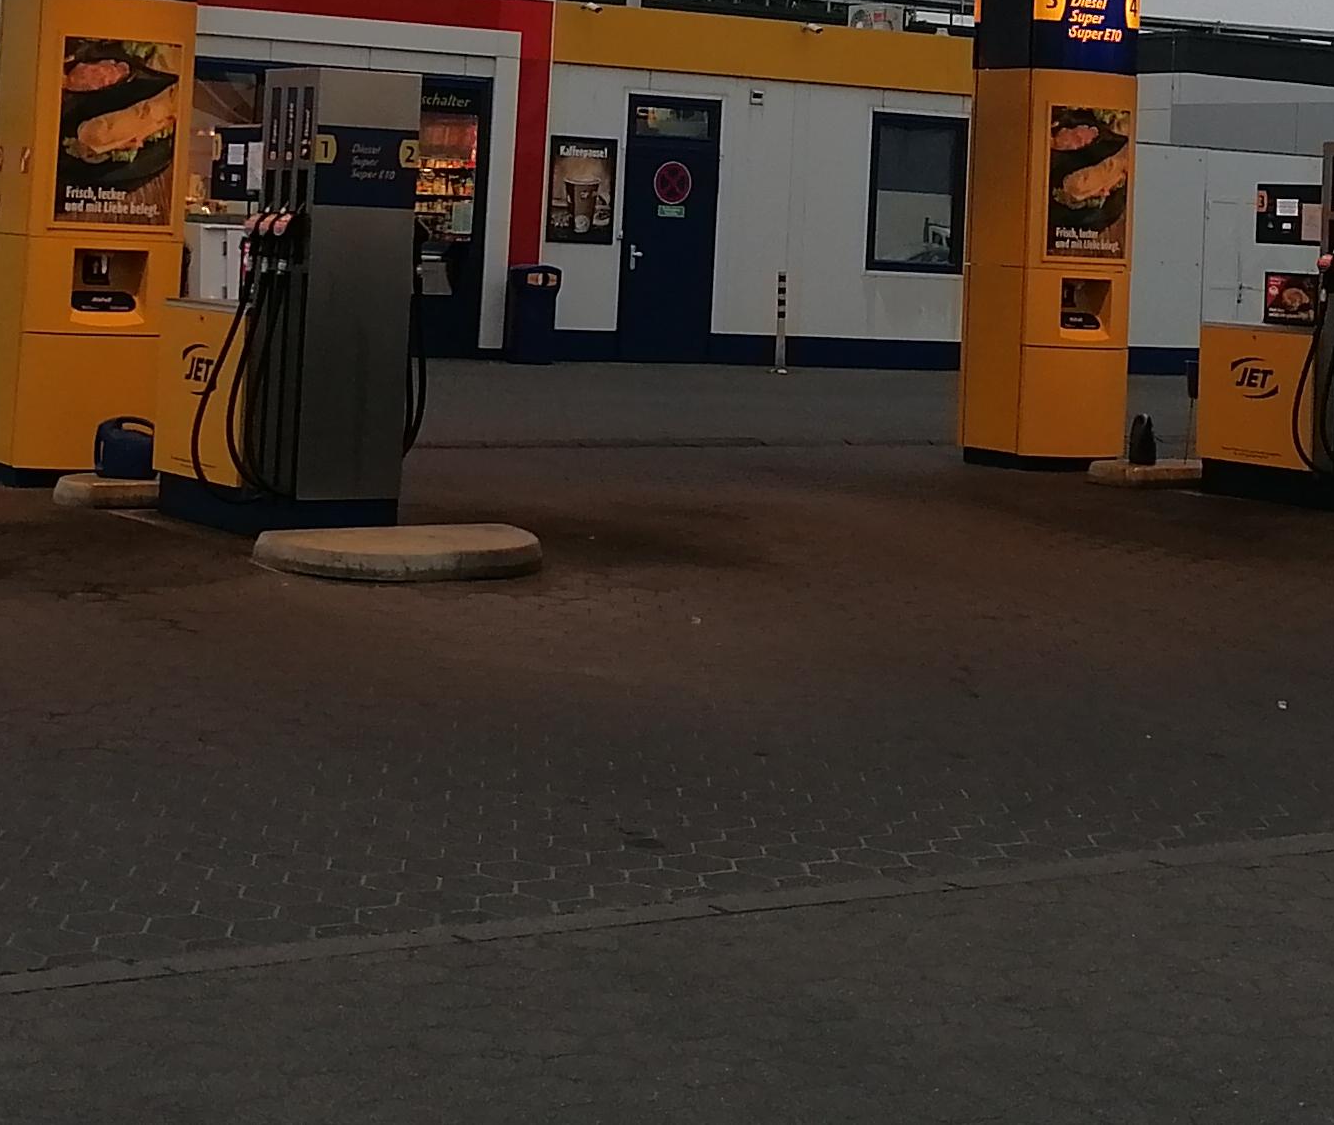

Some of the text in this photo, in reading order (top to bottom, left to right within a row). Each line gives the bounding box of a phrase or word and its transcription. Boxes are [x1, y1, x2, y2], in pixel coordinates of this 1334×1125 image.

[1068, 9, 1105, 27] Super
[1068, 25, 1123, 43] Super E10
[321, 141, 329, 158] 1
[405, 146, 415, 164] 2
[65, 184, 127, 202] Frisch, lecker
[64, 199, 84, 212] und
[85, 200, 102, 213] mit
[104, 201, 128, 214] Liebe
[185, 356, 214, 383] JET
[1235, 367, 1274, 388] JET
